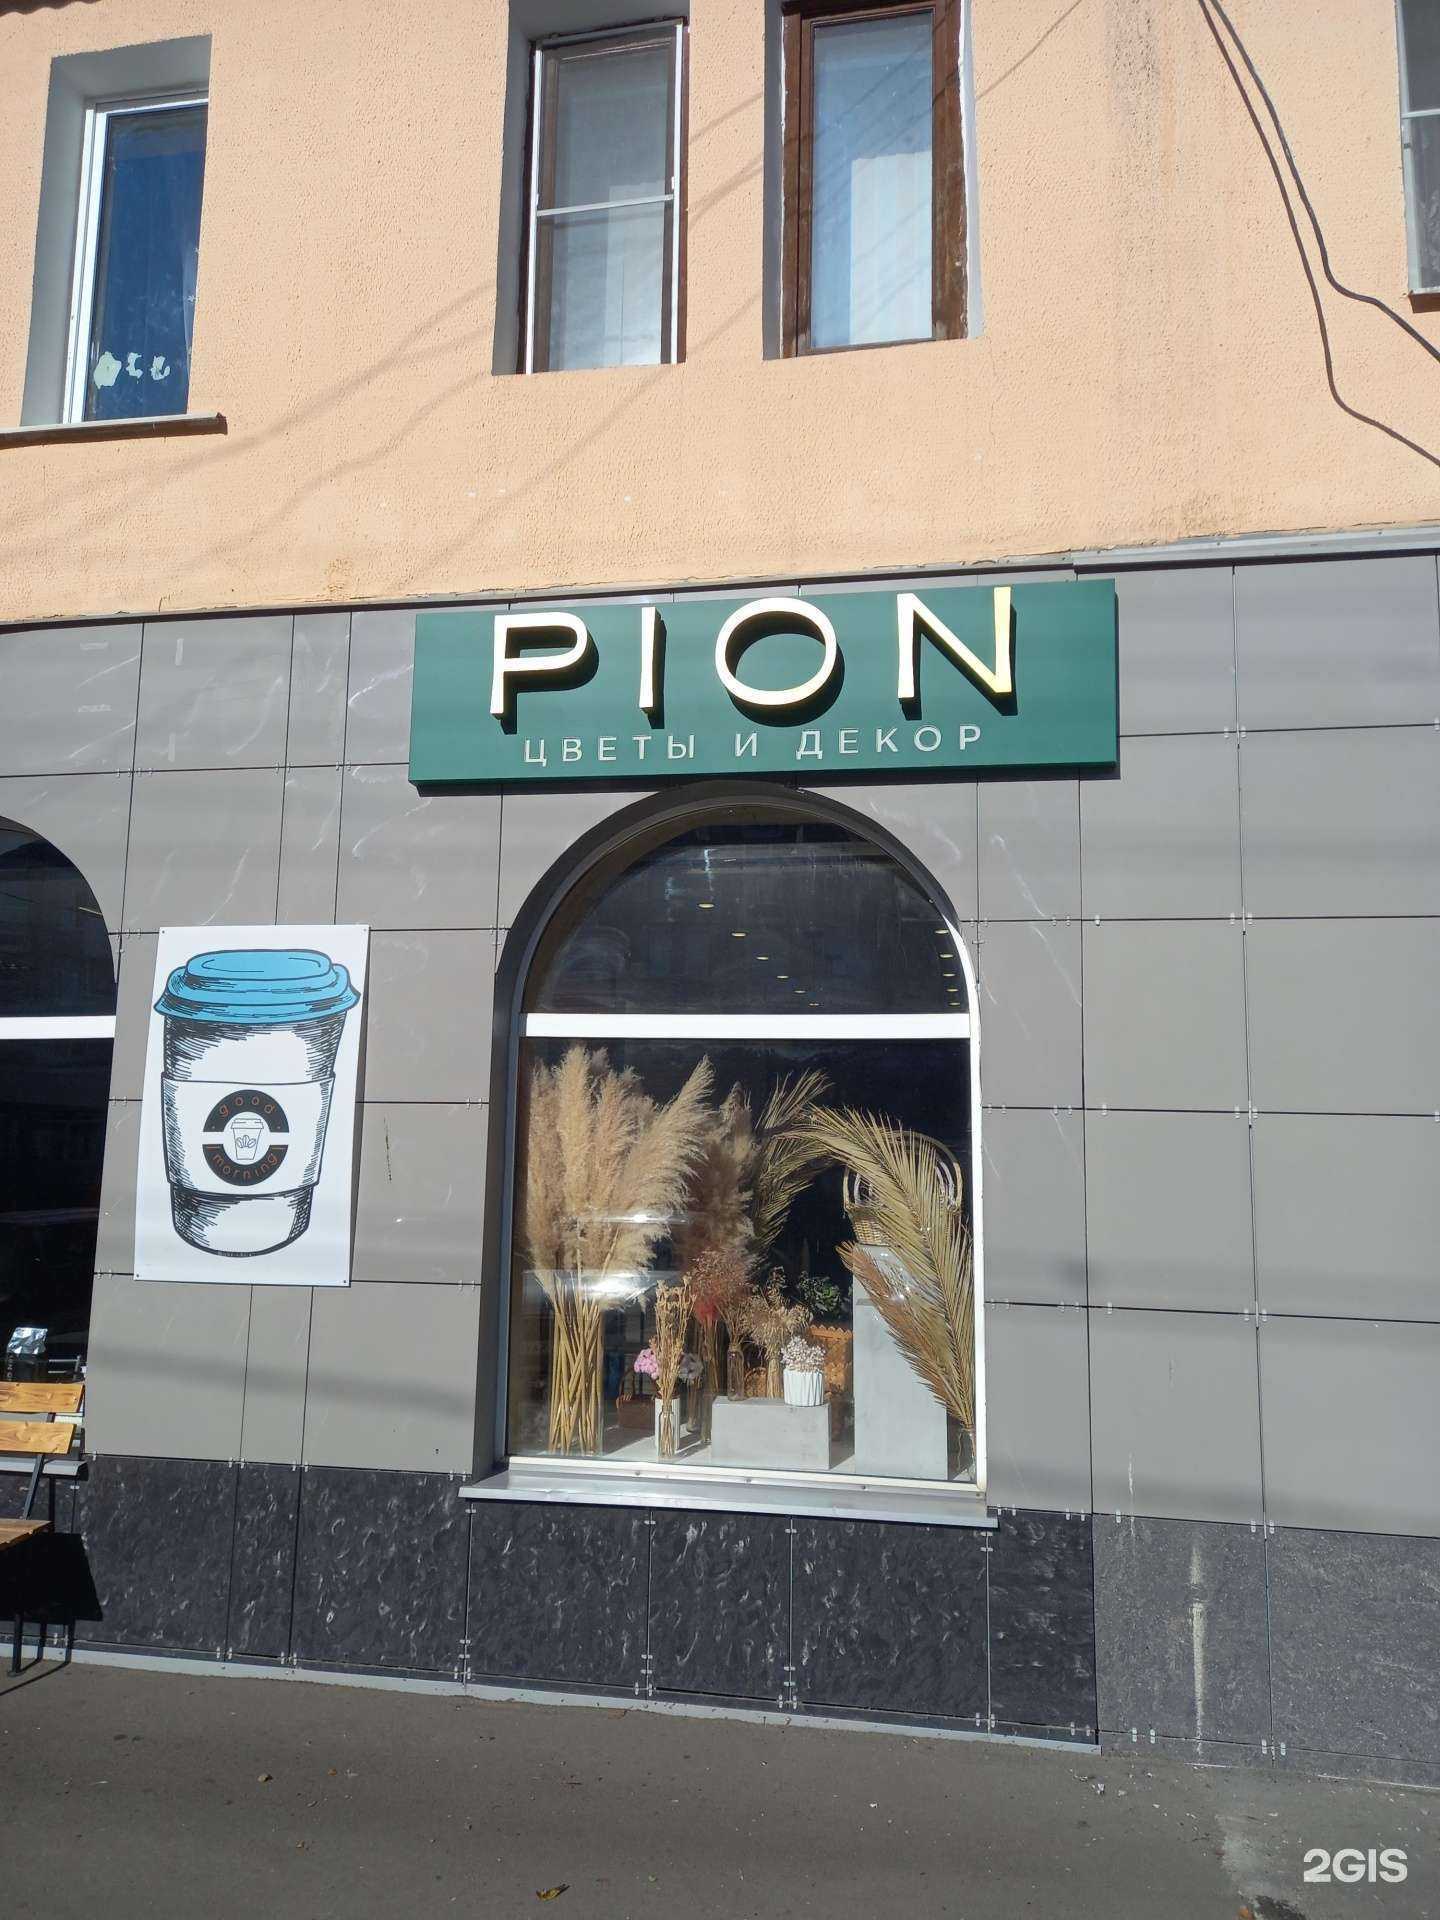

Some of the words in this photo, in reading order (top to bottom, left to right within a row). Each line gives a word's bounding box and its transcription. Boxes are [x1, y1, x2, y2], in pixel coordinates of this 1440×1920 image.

[490, 586, 1015, 715] PION
[523, 734, 696, 764] ЦВЕТЫ
[734, 732, 758, 758] И
[795, 725, 983, 760] ДЕКОР
